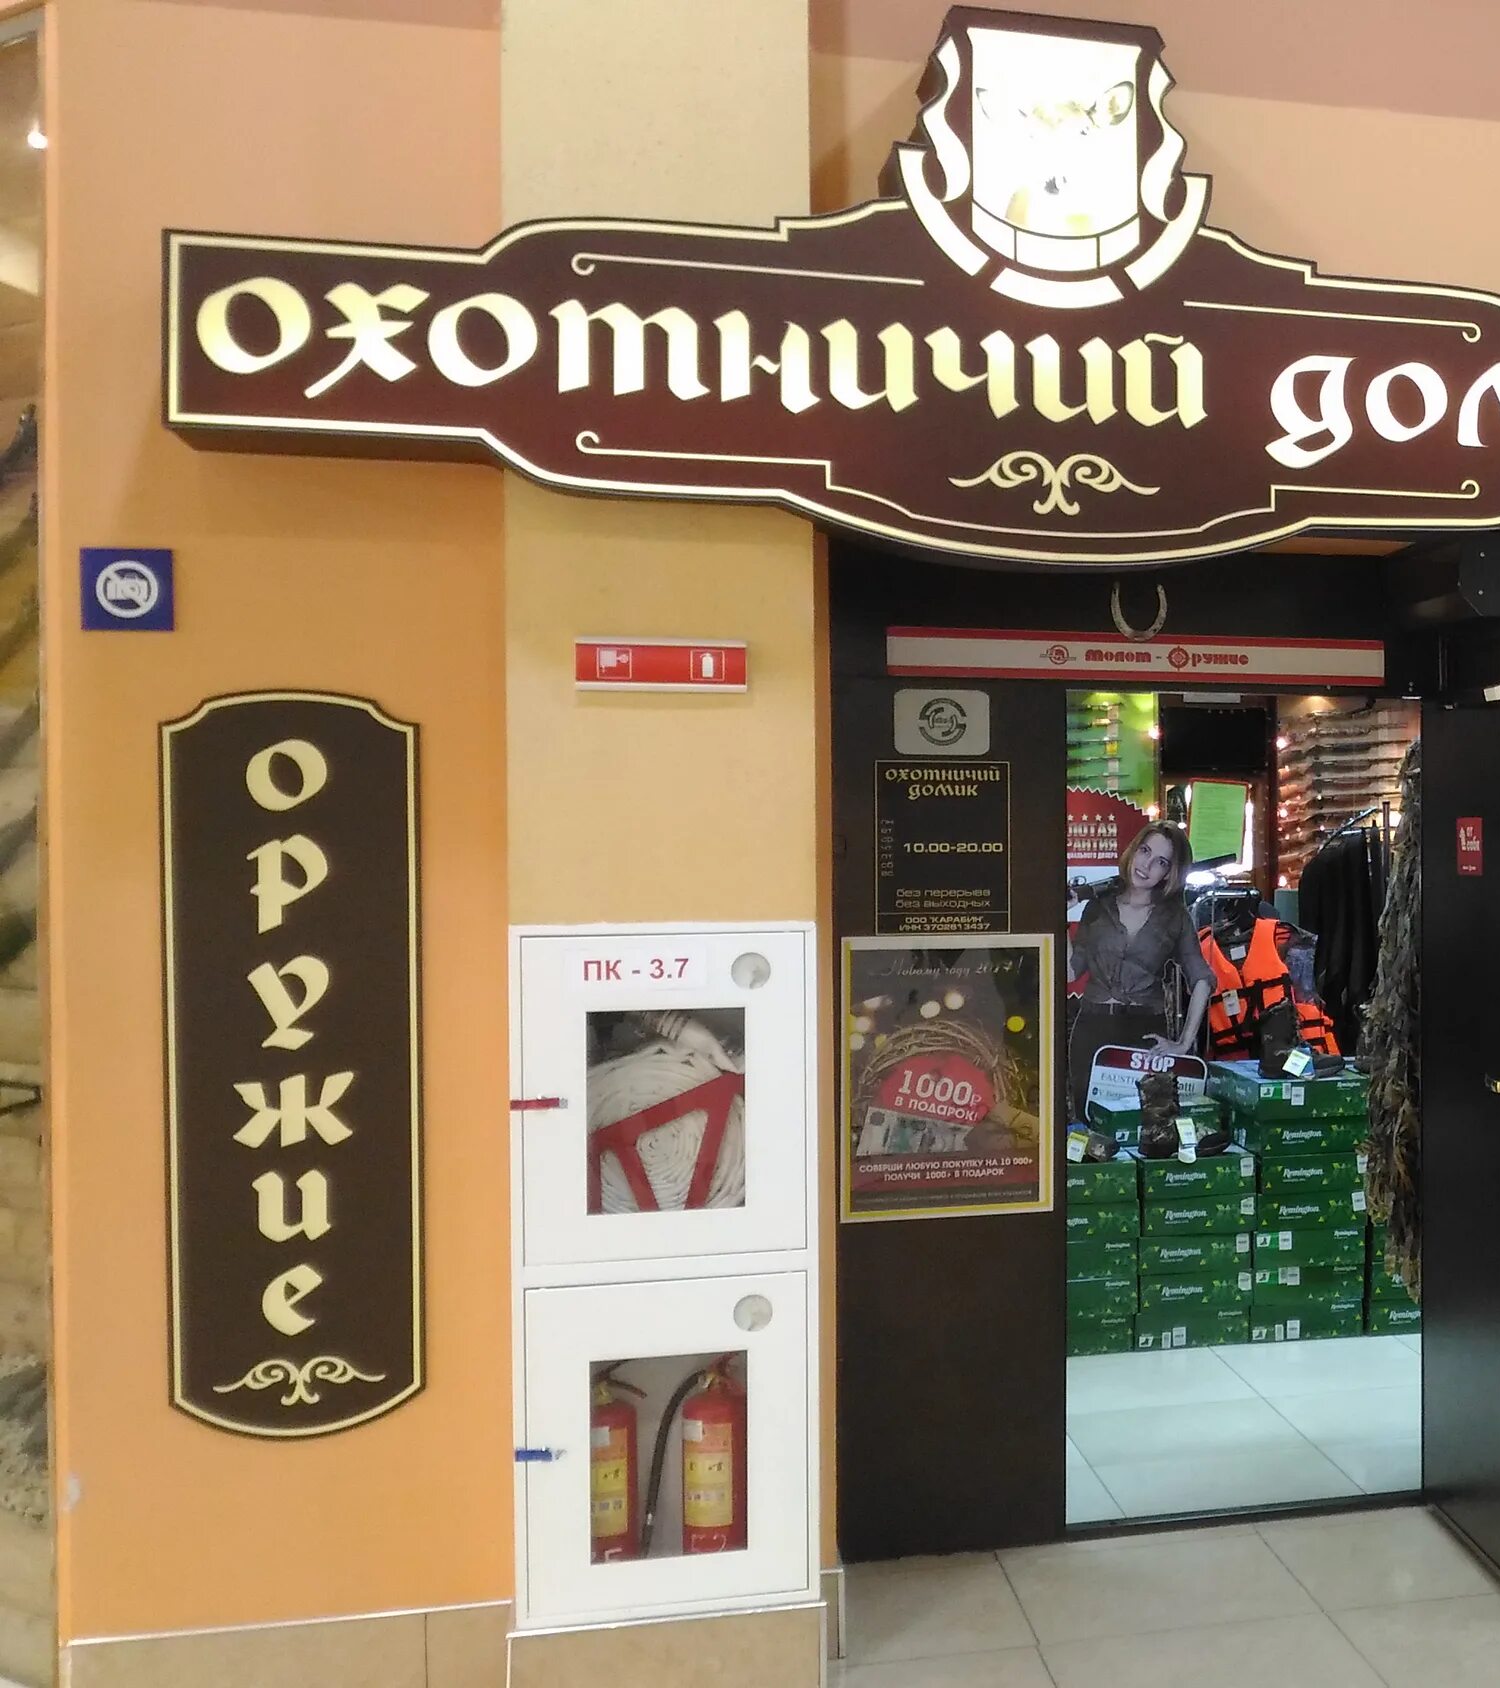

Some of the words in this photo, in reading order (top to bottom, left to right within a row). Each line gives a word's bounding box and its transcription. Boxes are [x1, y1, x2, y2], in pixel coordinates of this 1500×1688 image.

[1067, 823, 1117, 837] ЛОТАЯ
[903, 842, 1003, 853] 10.00-20.00
[896, 888, 921, 897] без
[924, 889, 990, 898] перерыва
[895, 899, 920, 908] без
[923, 900, 990, 909] выходных
[583, 960, 622, 981] ПК
[650, 958, 689, 979] 3.7
[1130, 1052, 1175, 1072] STOP
[894, 1096, 904, 1106] В
[1282, 1130, 1322, 1140] Remington
[905, 1161, 940, 1171] ЛЮБУЮ
[942, 1159, 984, 1169] ПОКУПКУ
[985, 1159, 998, 1167] НА
[1001, 1158, 1011, 1166] 10
[884, 1172, 920, 1182] ПОЛУЧИ
[954, 1170, 960, 1178] В
[962, 1168, 1004, 1178] ПОДАРОК
[1165, 1171, 1207, 1182] Remington
[1283, 1168, 1324, 1178] Remington
[1164, 1209, 1207, 1220] Remington
[1278, 1205, 1320, 1215] Remington
[1159, 1247, 1201, 1259] Remington
[1161, 1286, 1203, 1297] Remington
